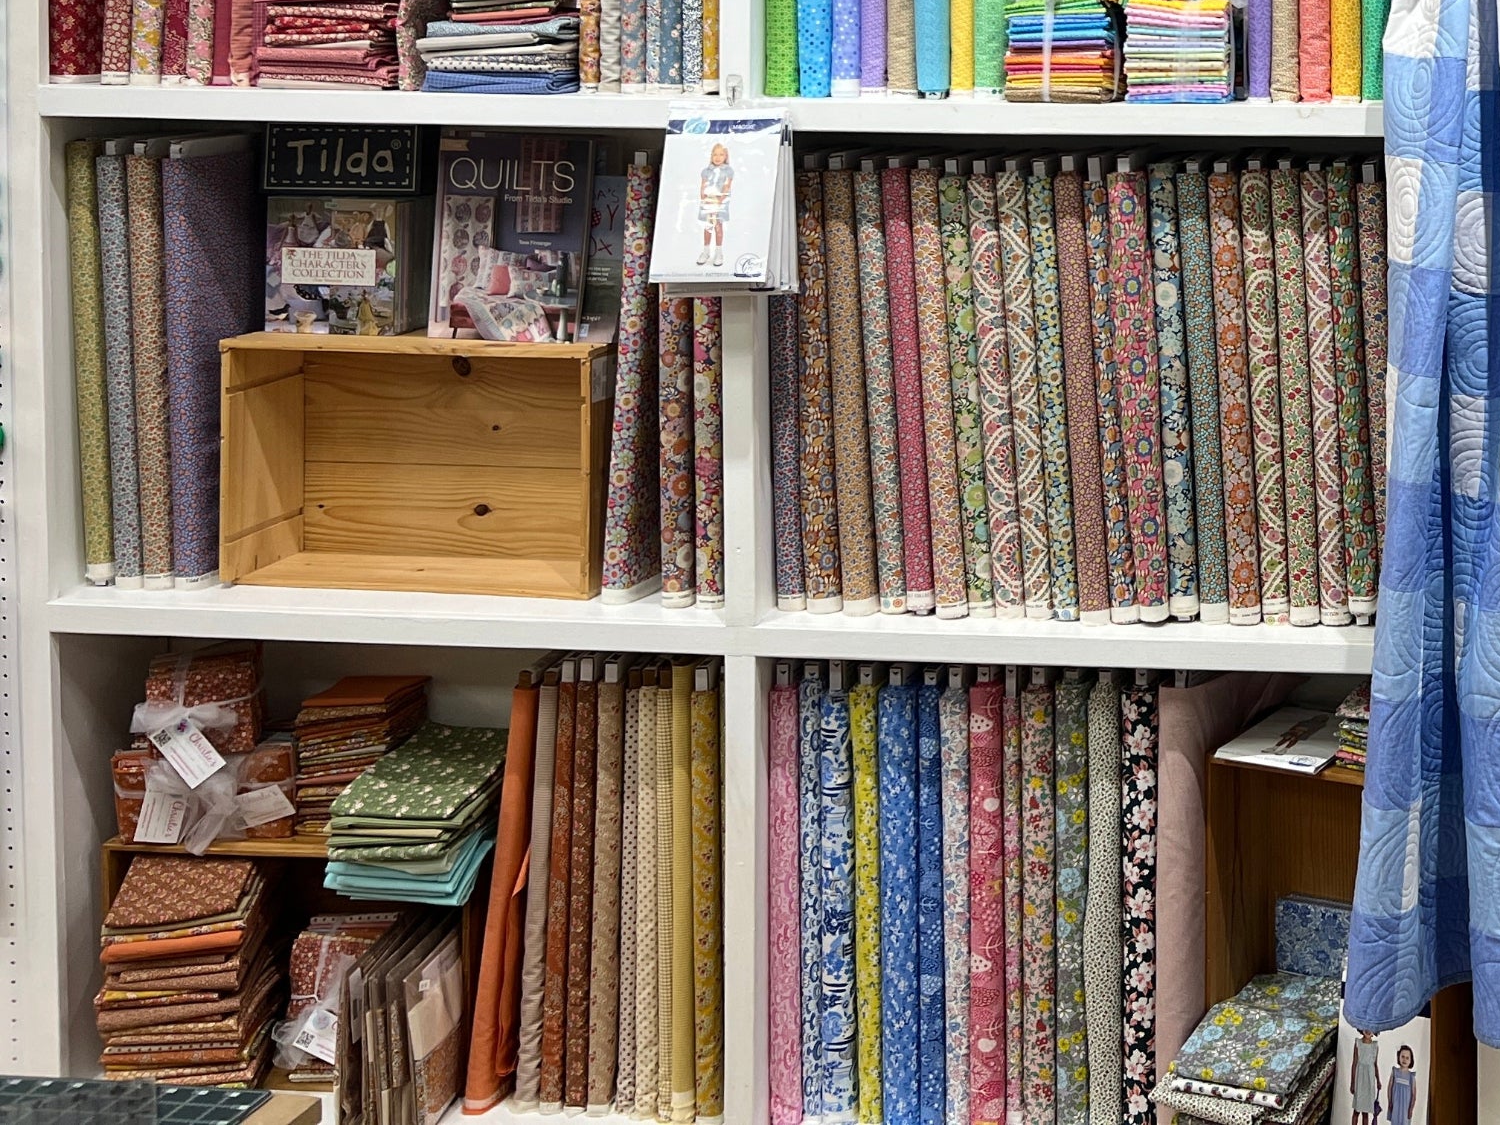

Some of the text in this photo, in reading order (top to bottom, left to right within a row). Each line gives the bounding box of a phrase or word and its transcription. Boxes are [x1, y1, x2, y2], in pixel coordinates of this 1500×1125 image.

[286, 138, 394, 177] Tilda
[450, 157, 576, 193] QUILTS
[504, 194, 523, 203] From
[548, 195, 573, 204] Studio
[302, 250, 357, 261] THE TILDA
[291, 259, 367, 270] CHARACTERS
[292, 268, 365, 279] COLLECTION
